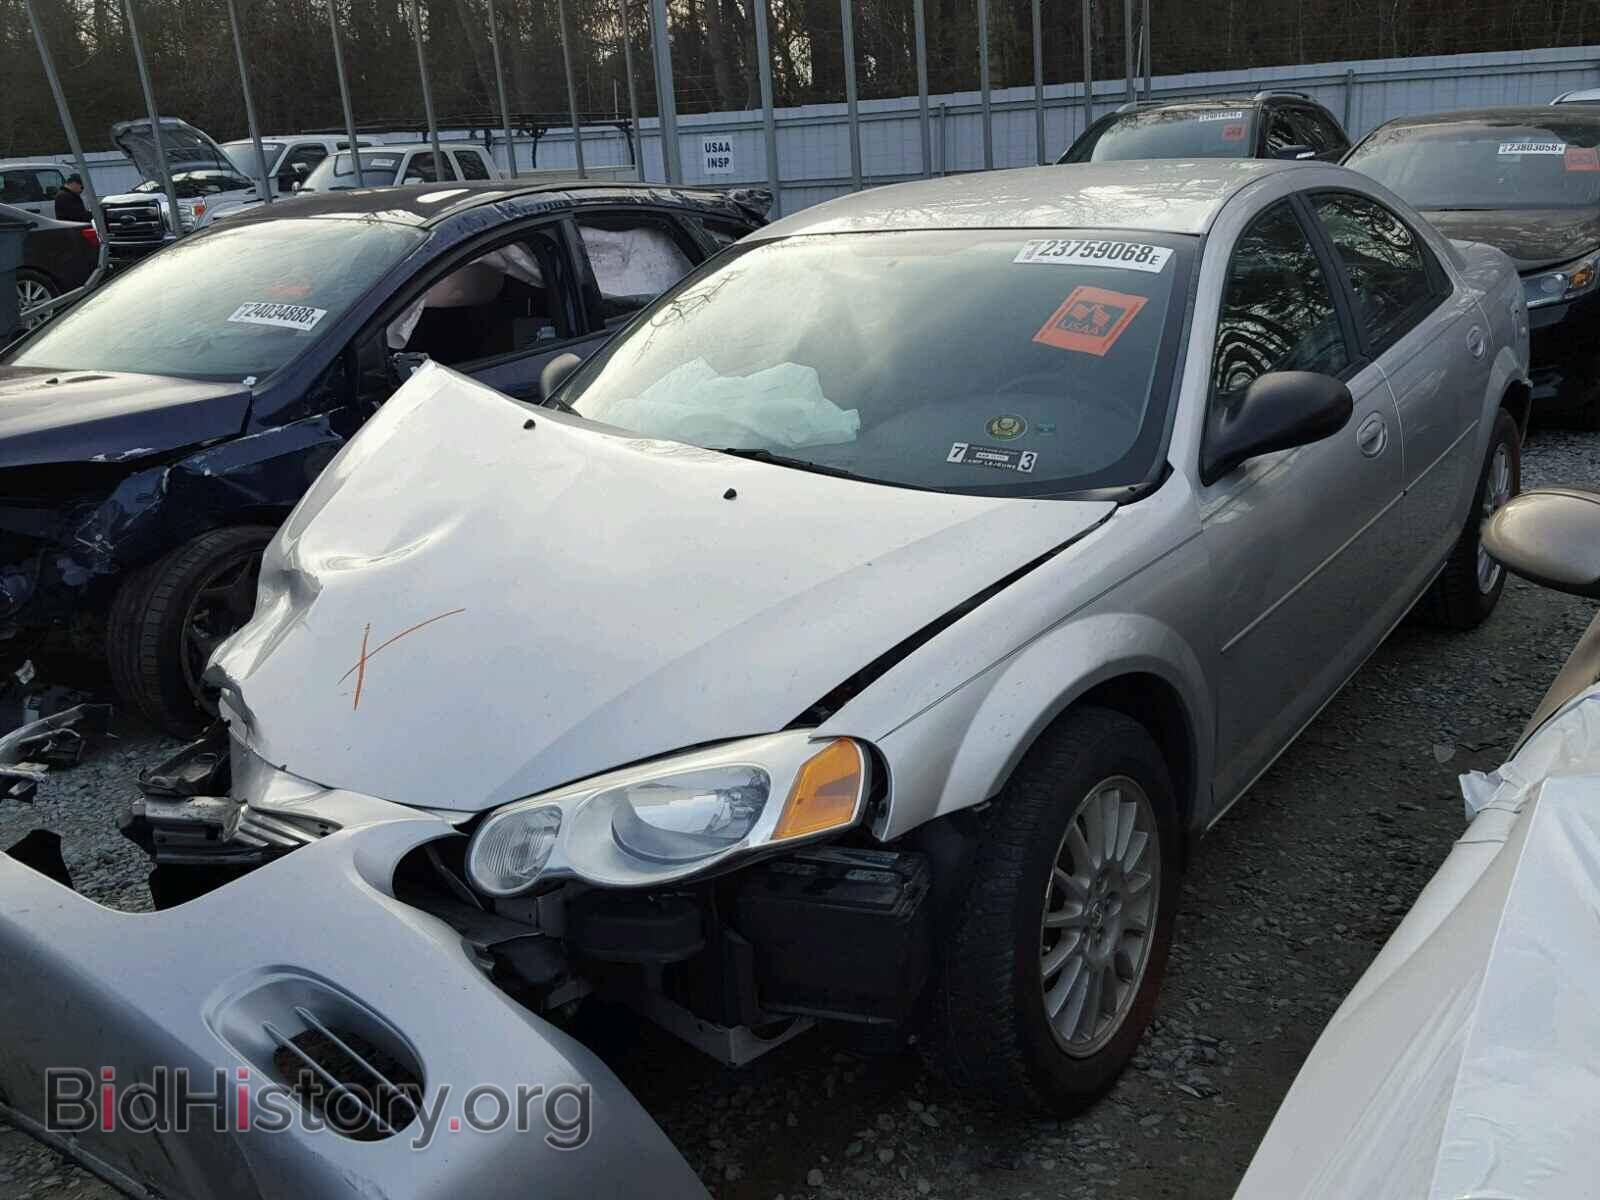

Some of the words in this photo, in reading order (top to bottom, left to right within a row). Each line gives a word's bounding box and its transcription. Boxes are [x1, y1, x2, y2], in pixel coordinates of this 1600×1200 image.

[704, 142, 731, 153] USAA
[707, 157, 730, 169] INSP
[952, 446, 966, 458] 7
[1021, 453, 1035, 470] 3
